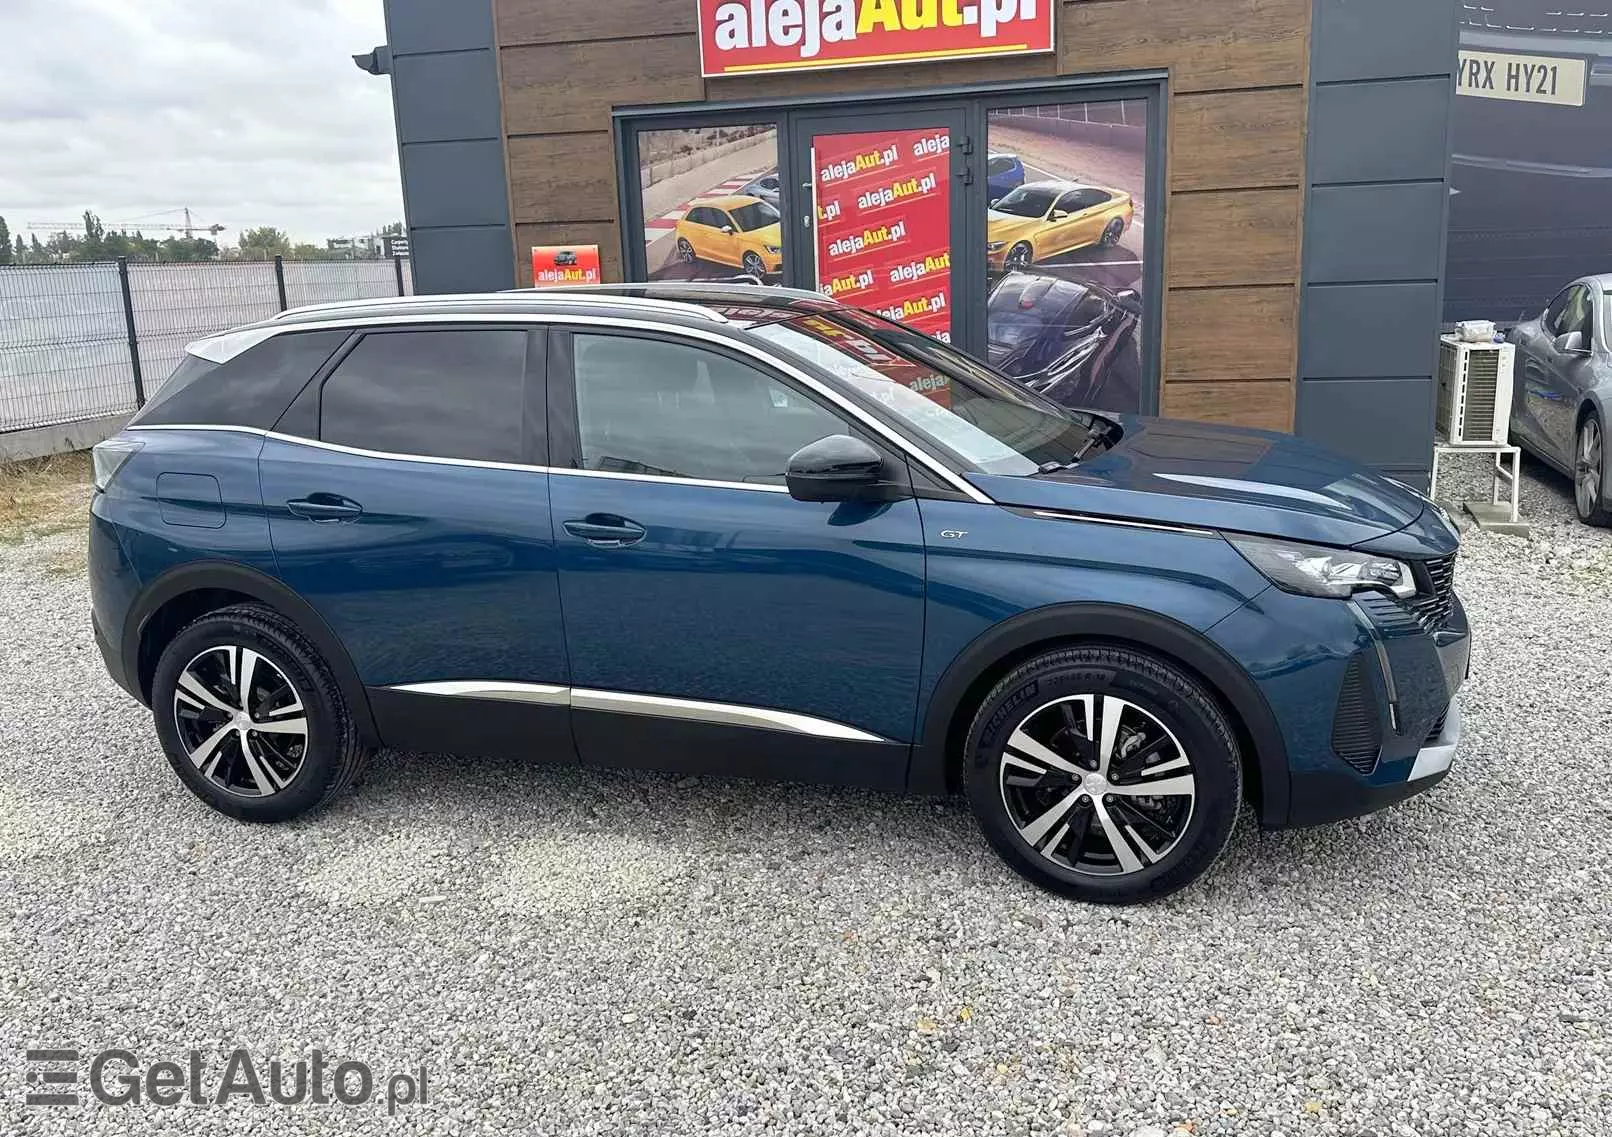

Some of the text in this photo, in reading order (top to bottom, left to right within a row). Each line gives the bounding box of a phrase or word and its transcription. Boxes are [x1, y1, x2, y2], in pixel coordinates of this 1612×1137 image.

[1457, 58, 1559, 96] YRX HY21
[912, 133, 950, 156] aleja
[820, 145, 898, 182] alejaAut.pl
[857, 173, 936, 209] alejaAut.pl
[828, 221, 906, 256] alejaAut.pl
[538, 268, 596, 284] alejaAut.pl
[940, 530, 969, 539] GT
